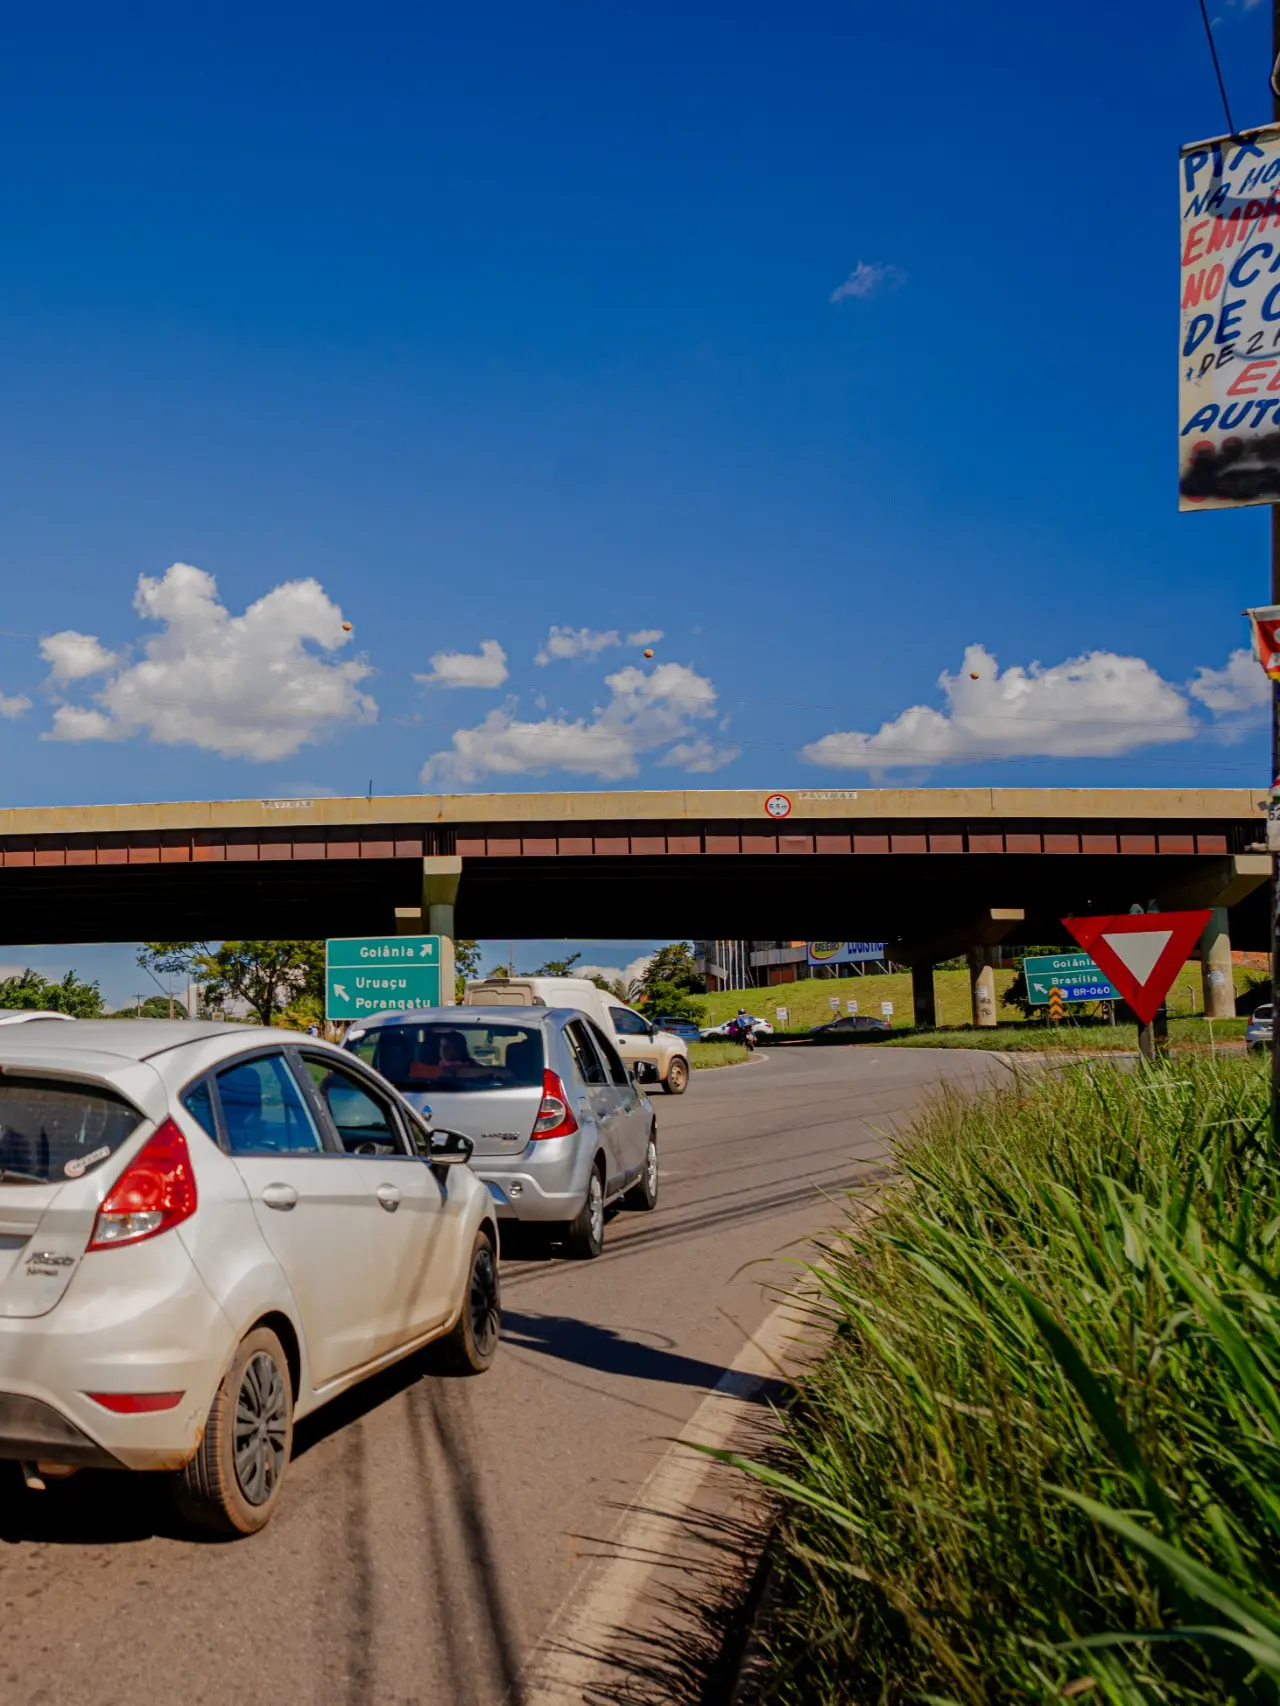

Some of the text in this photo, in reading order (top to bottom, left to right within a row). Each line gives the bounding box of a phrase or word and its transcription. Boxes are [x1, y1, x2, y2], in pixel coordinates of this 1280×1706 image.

[1185, 132, 1265, 193] PIX
[1184, 183, 1231, 219] NA
[1181, 263, 1224, 309] NO
[1183, 299, 1247, 357] DE
[1246, 330, 1265, 355] 2
[360, 944, 415, 958] Goiânia
[355, 976, 407, 990] Uruaçu
[1051, 974, 1098, 985] Brasília
[1073, 986, 1110, 996] BR-060
